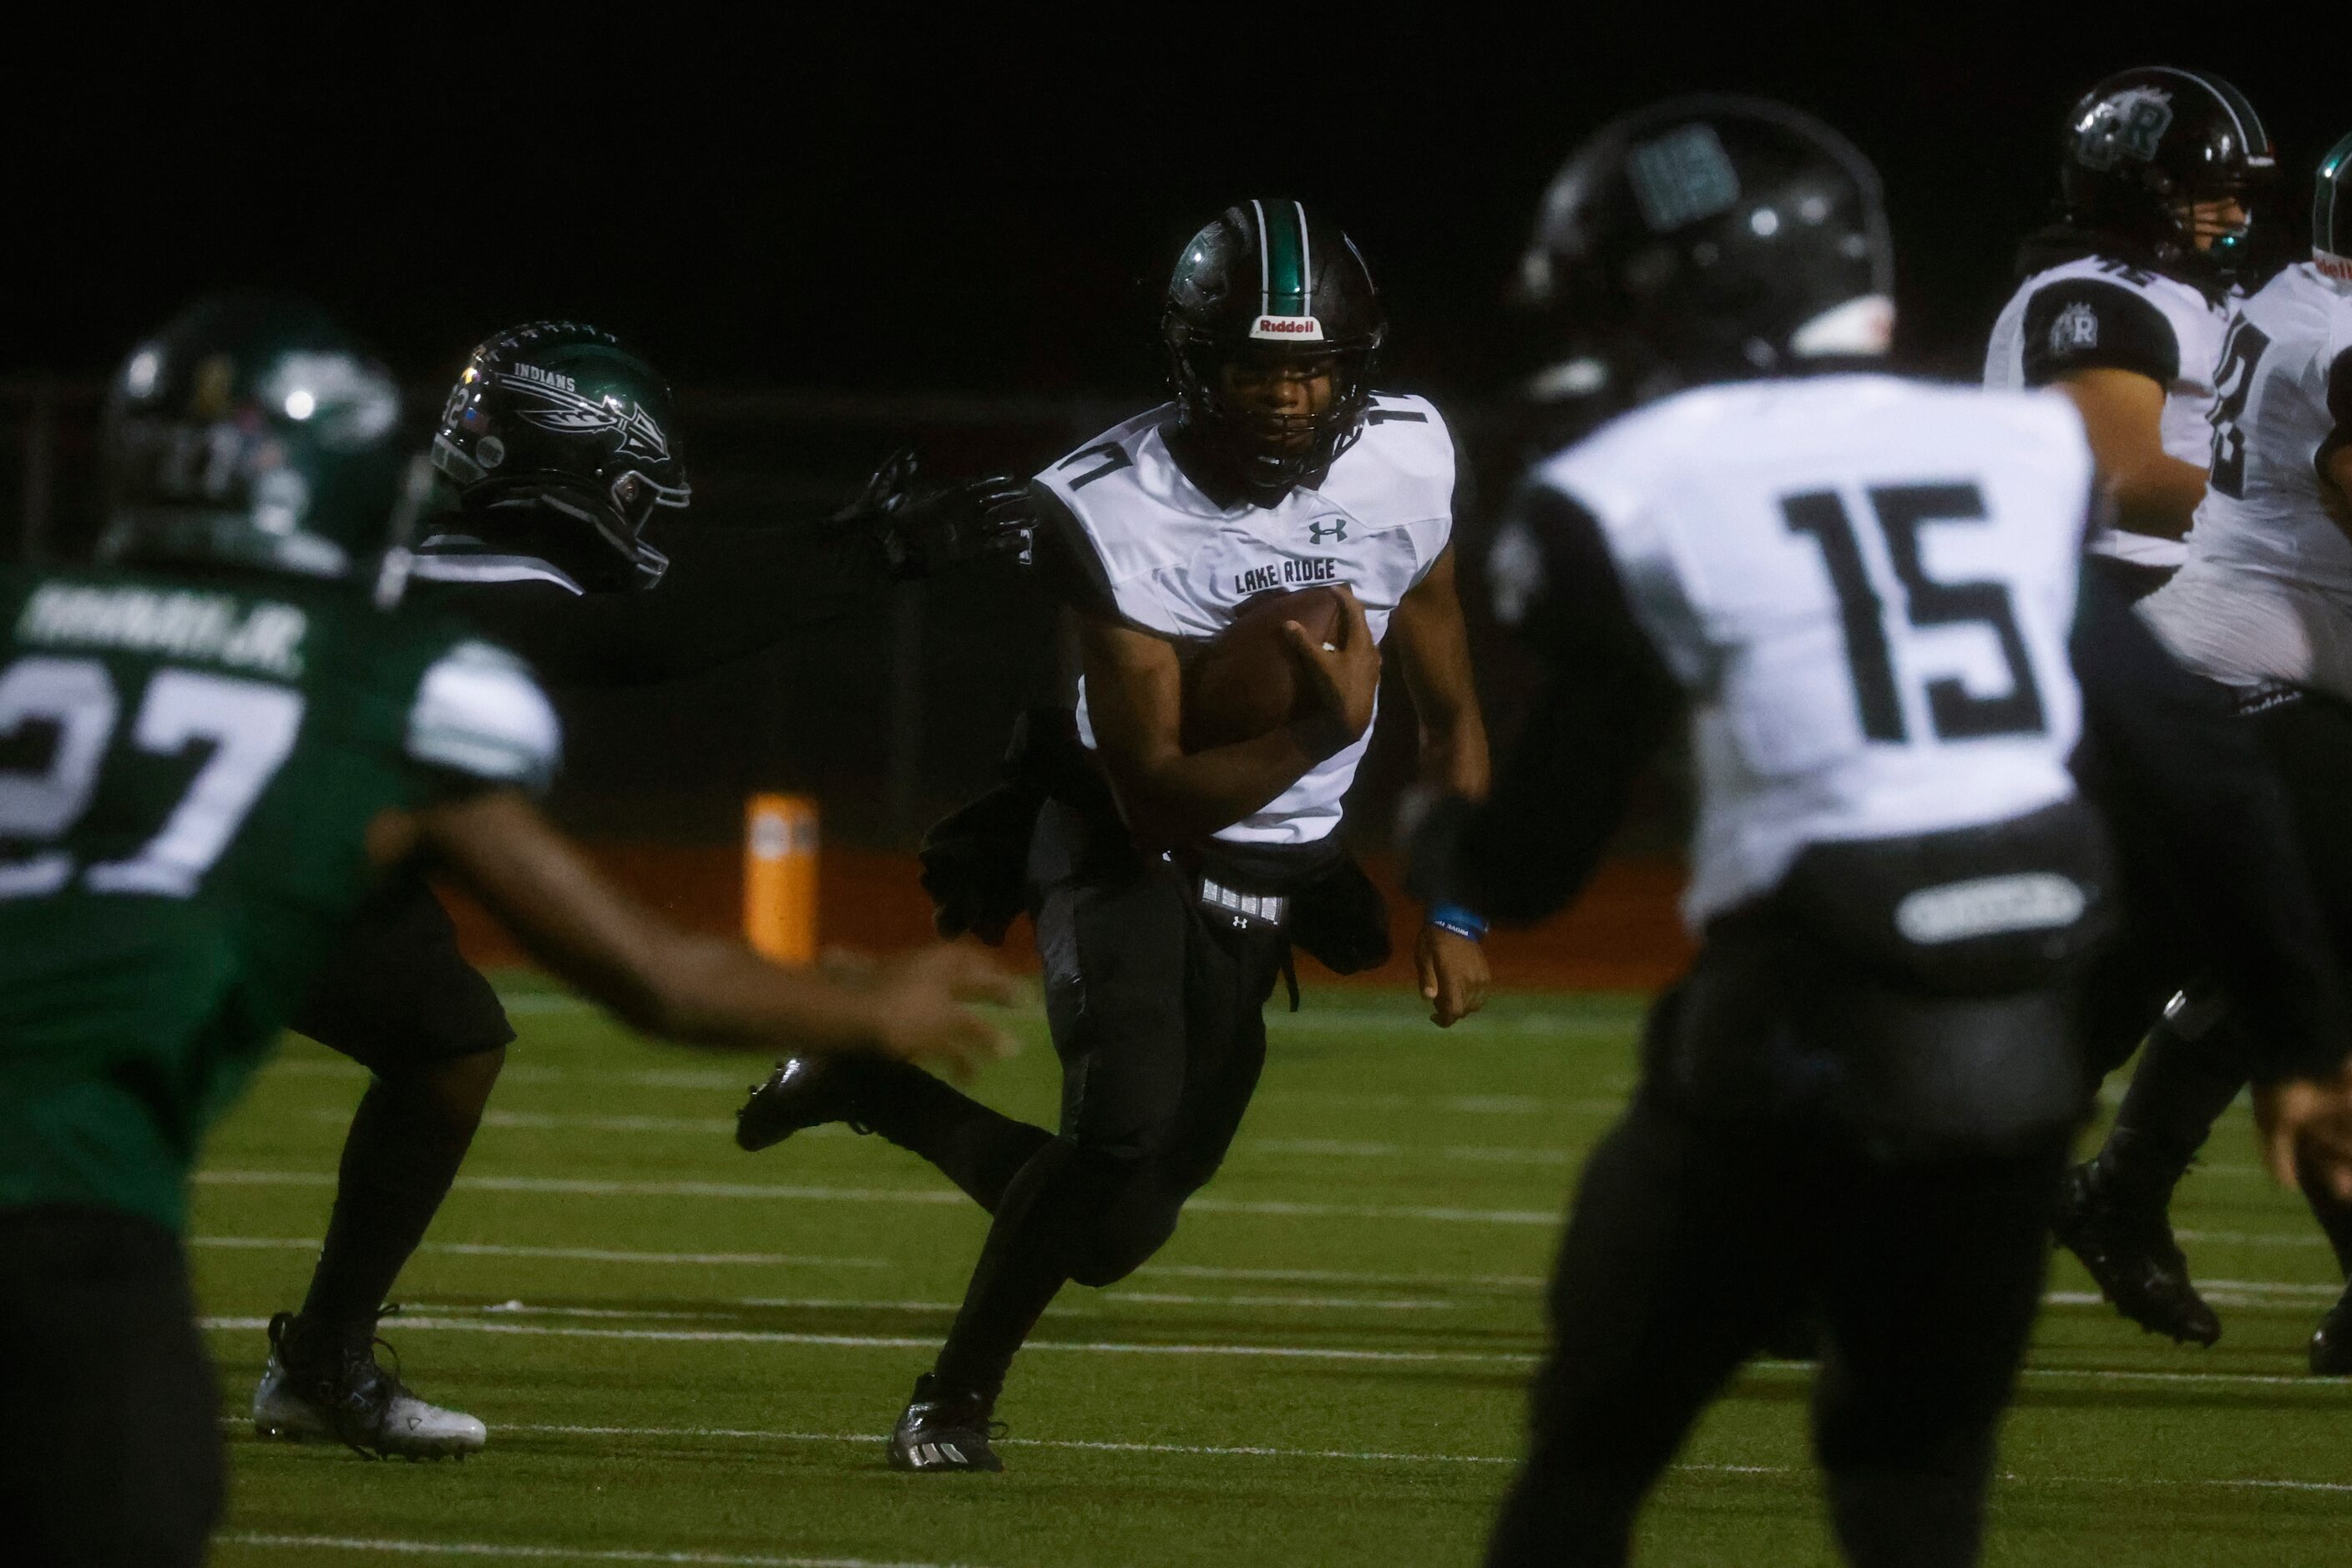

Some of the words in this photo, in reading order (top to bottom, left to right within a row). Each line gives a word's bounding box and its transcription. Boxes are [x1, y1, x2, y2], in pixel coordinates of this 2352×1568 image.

[1260, 320, 1313, 333] Riddell
[514, 362, 575, 392] INDIANS
[1235, 564, 1278, 594] LAKE
[1284, 559, 1335, 583] RIDGE
[1779, 484, 2049, 742] 15
[0, 656, 306, 898] 27
